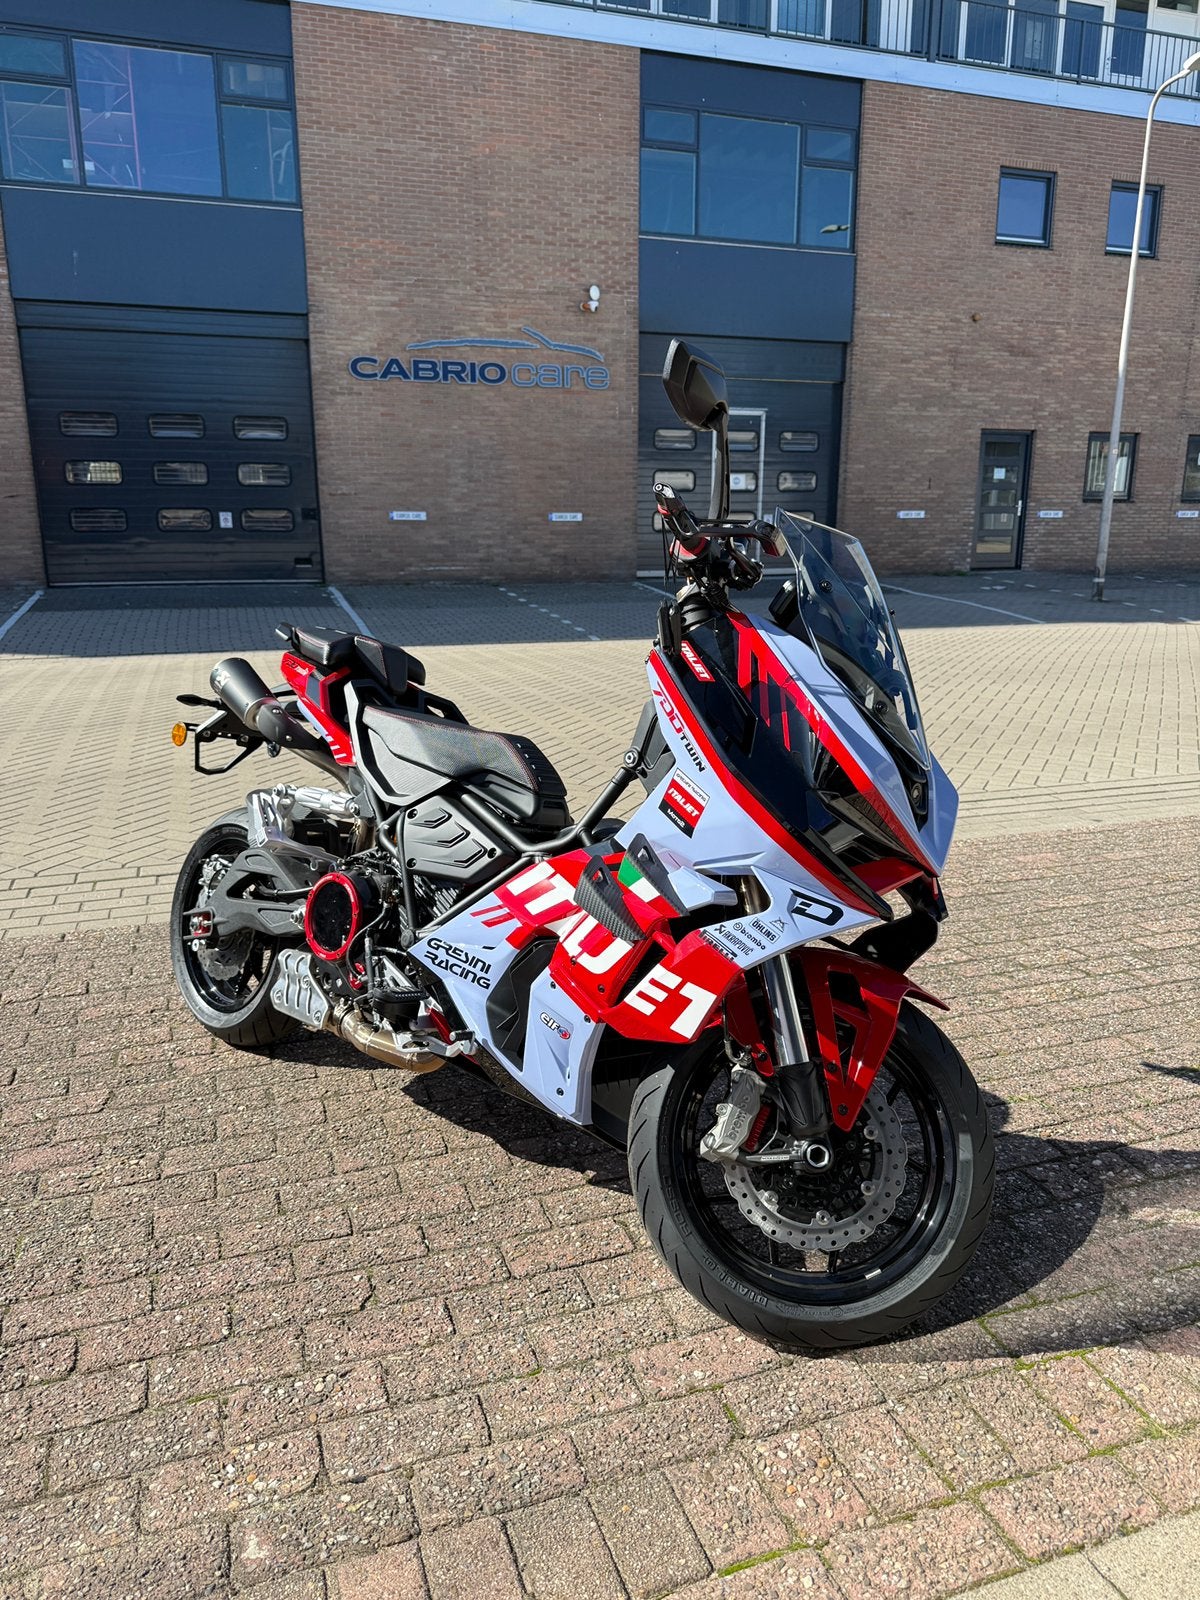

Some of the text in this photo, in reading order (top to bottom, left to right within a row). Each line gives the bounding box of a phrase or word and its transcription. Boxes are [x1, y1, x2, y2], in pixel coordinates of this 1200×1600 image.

[349, 356, 610, 390] CABRIO care
[681, 642, 711, 680] ITALJET
[680, 732, 706, 773] TWIN
[667, 787, 700, 817] ITALJET
[741, 926, 766, 951] brembo
[751, 919, 777, 942] ÖHLINS
[424, 950, 491, 990] RACING
[427, 937, 492, 975] GRESINI
[540, 1011, 560, 1031] elf
